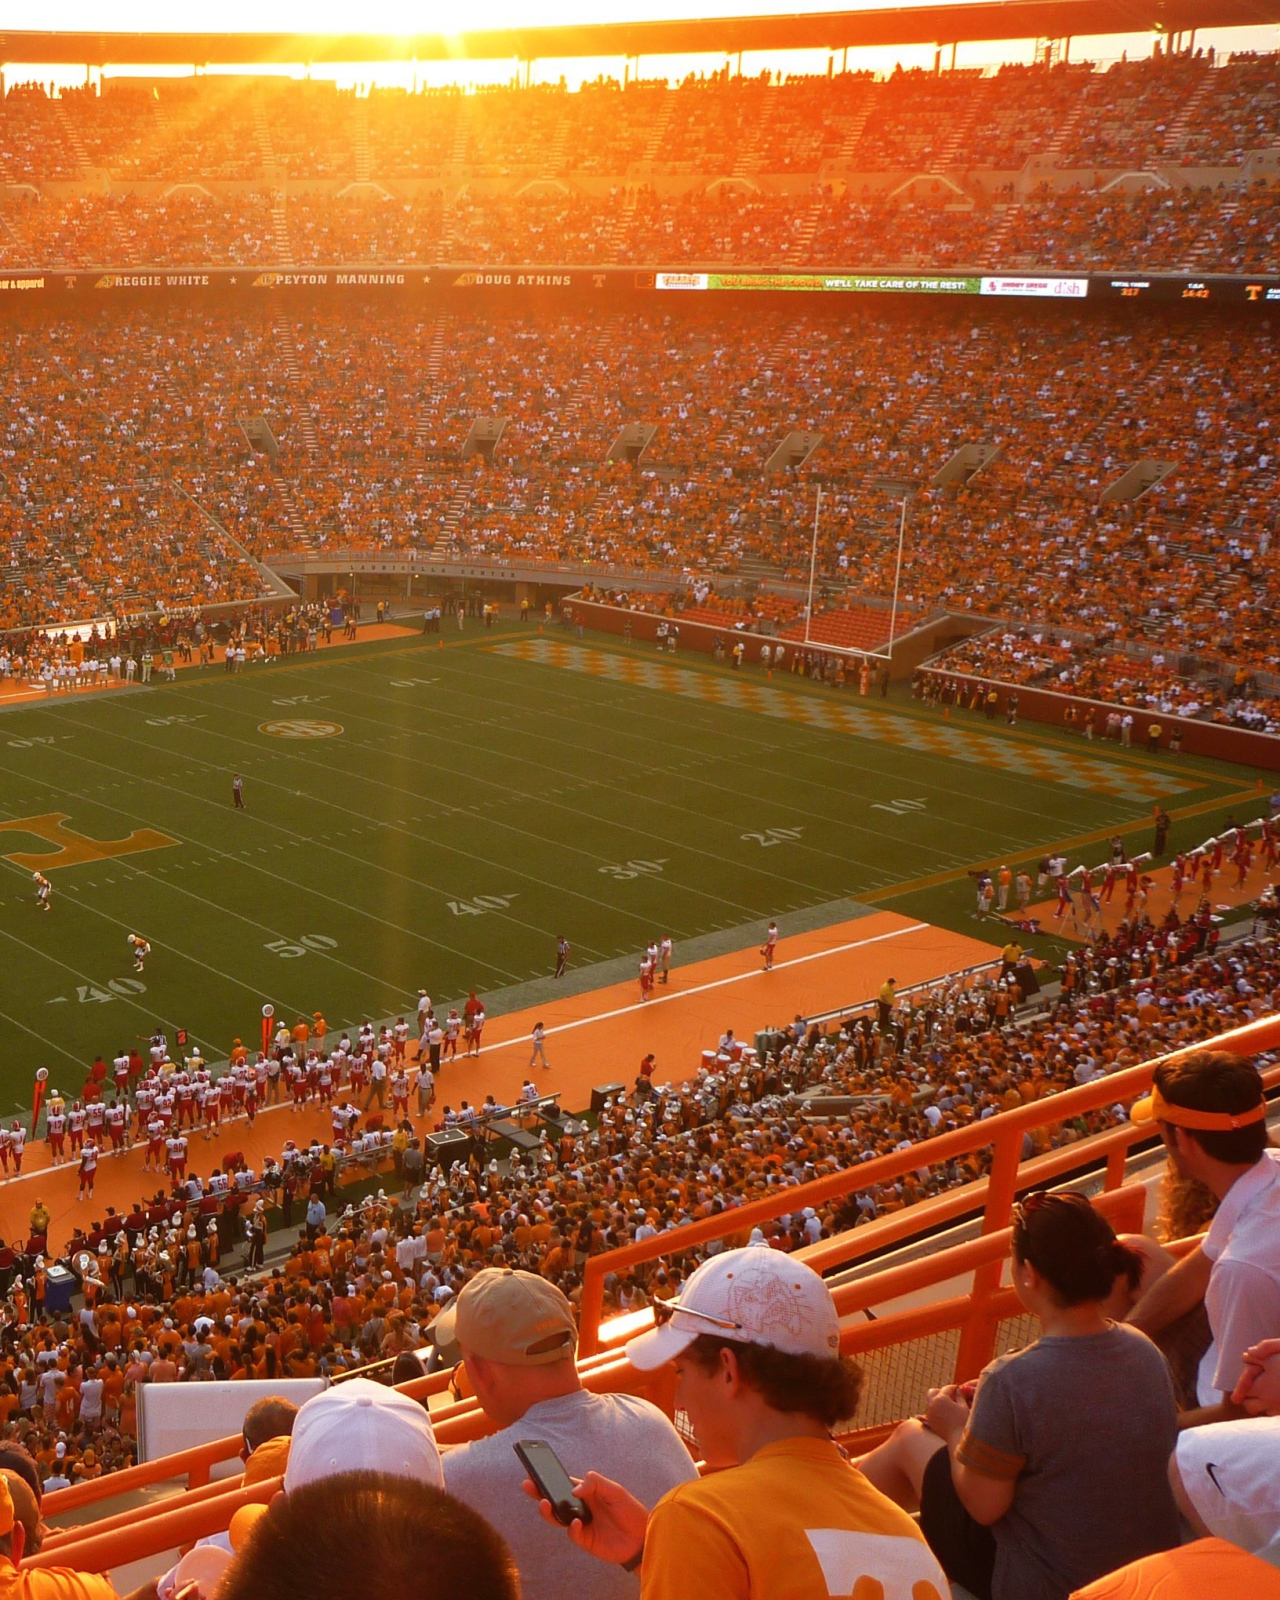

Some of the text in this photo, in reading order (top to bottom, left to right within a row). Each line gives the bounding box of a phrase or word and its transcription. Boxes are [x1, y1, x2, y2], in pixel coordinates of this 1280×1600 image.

[16, 277, 45, 290] apparel
[115, 276, 161, 287] REGGIE
[166, 275, 209, 286] WHITE
[276, 275, 328, 285] PEYTON
[336, 274, 405, 285] MANNING
[475, 274, 512, 285] DOUG
[517, 275, 571, 286] ATKINS
[721, 277, 739, 287] YOU
[769, 277, 787, 287] THE
[825, 279, 852, 288] WE'LL
[854, 279, 878, 288] TAKE
[879, 280, 905, 289] CARE
[906, 280, 919, 289] OF
[920, 281, 939, 289] THE
[940, 281, 965, 290] REST!
[1054, 282, 1081, 295] dish
[1245, 285, 1263, 300] T
[870, 798, 927, 816] 10
[740, 827, 803, 847] 20
[598, 859, 664, 880] 30
[446, 895, 511, 916] 40
[263, 934, 338, 958] 50
[77, 978, 147, 1003] 40
